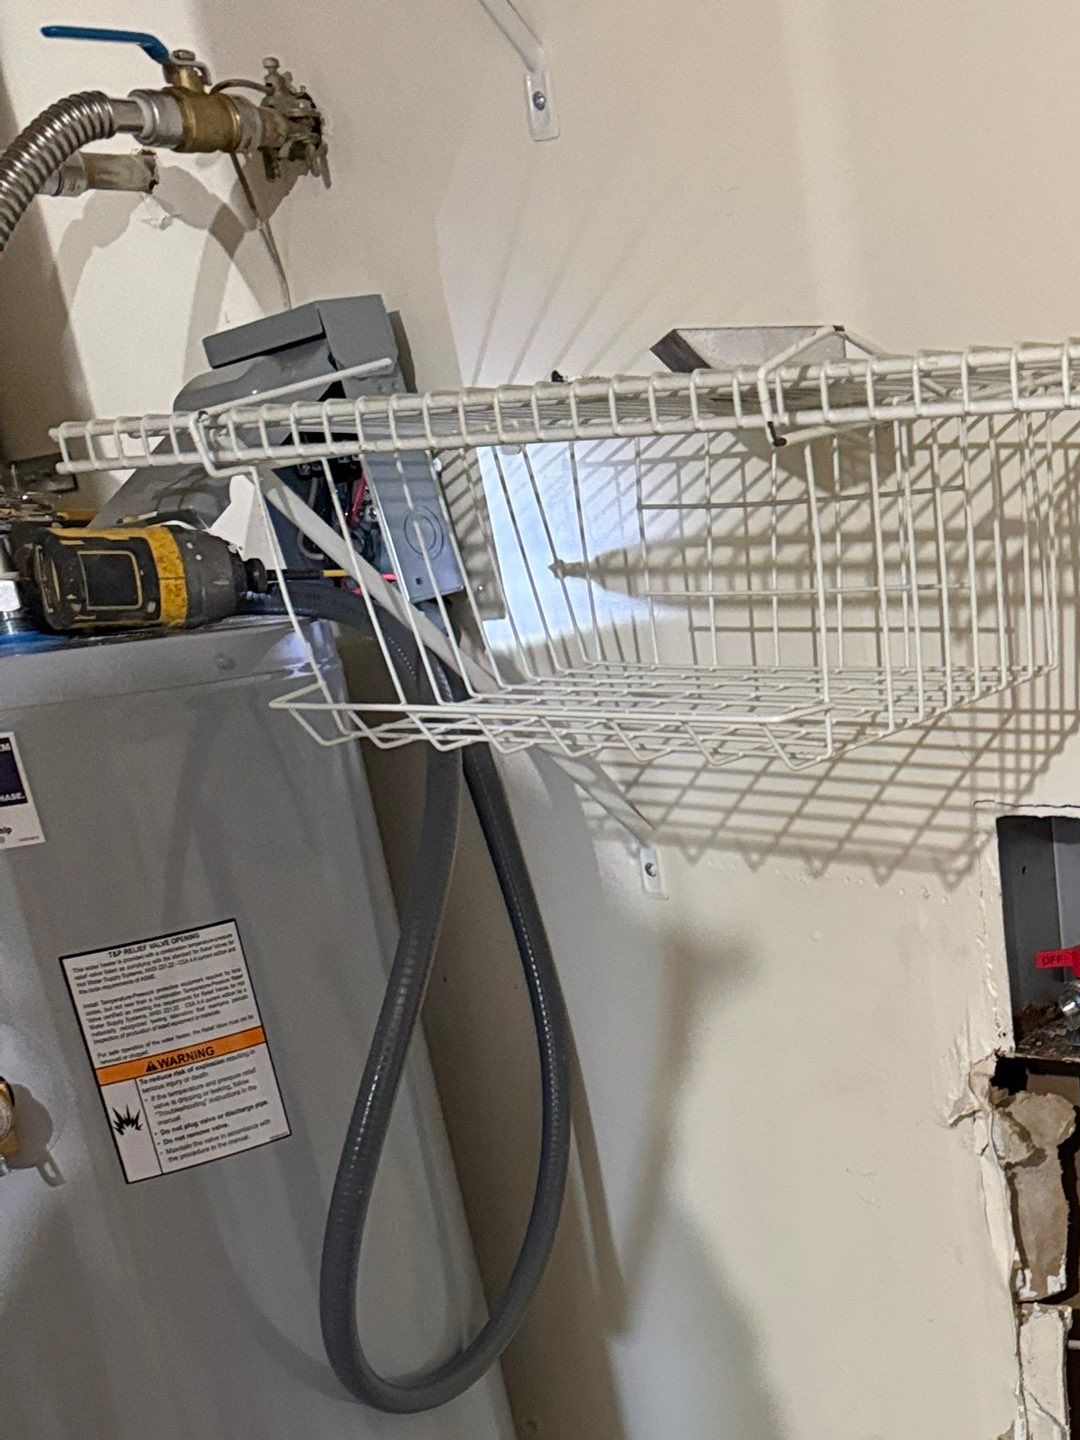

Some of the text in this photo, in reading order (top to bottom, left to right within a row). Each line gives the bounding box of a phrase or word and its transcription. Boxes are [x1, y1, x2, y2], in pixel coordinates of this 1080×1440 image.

[109, 932, 200, 958] T&P RELIEF VALVE OPENING
[157, 1045, 215, 1069] WARNING
[149, 1072, 173, 1083] reduce
[173, 1068, 186, 1077] risk
[195, 1057, 226, 1072] explosion
[142, 1083, 165, 1094] serious
[166, 1078, 183, 1089] injury
[156, 1092, 167, 1100] the
[167, 1083, 204, 1099] temperature
[205, 1079, 216, 1087] and
[217, 1072, 242, 1085] pressure
[242, 1067, 256, 1076] relief
[209, 1089, 241, 1103] instructions
[247, 1084, 258, 1092] the
[153, 1101, 170, 1110] valve
[177, 1092, 203, 1105] dripping
[171, 1124, 184, 1133] not
[183, 1120, 200, 1131] plug
[199, 1115, 216, 1125] valve
[225, 1103, 255, 1119] discharge
[163, 1121, 229, 1145] Do not remove valve.
[165, 1142, 193, 1154] Maintain
[193, 1139, 204, 1147] the
[203, 1134, 220, 1144] valve
[227, 1122, 259, 1137] accordance
[259, 1118, 271, 1126] with
[168, 1155, 179, 1163] the
[179, 1146, 211, 1161] procedure
[217, 1141, 227, 1149] the
